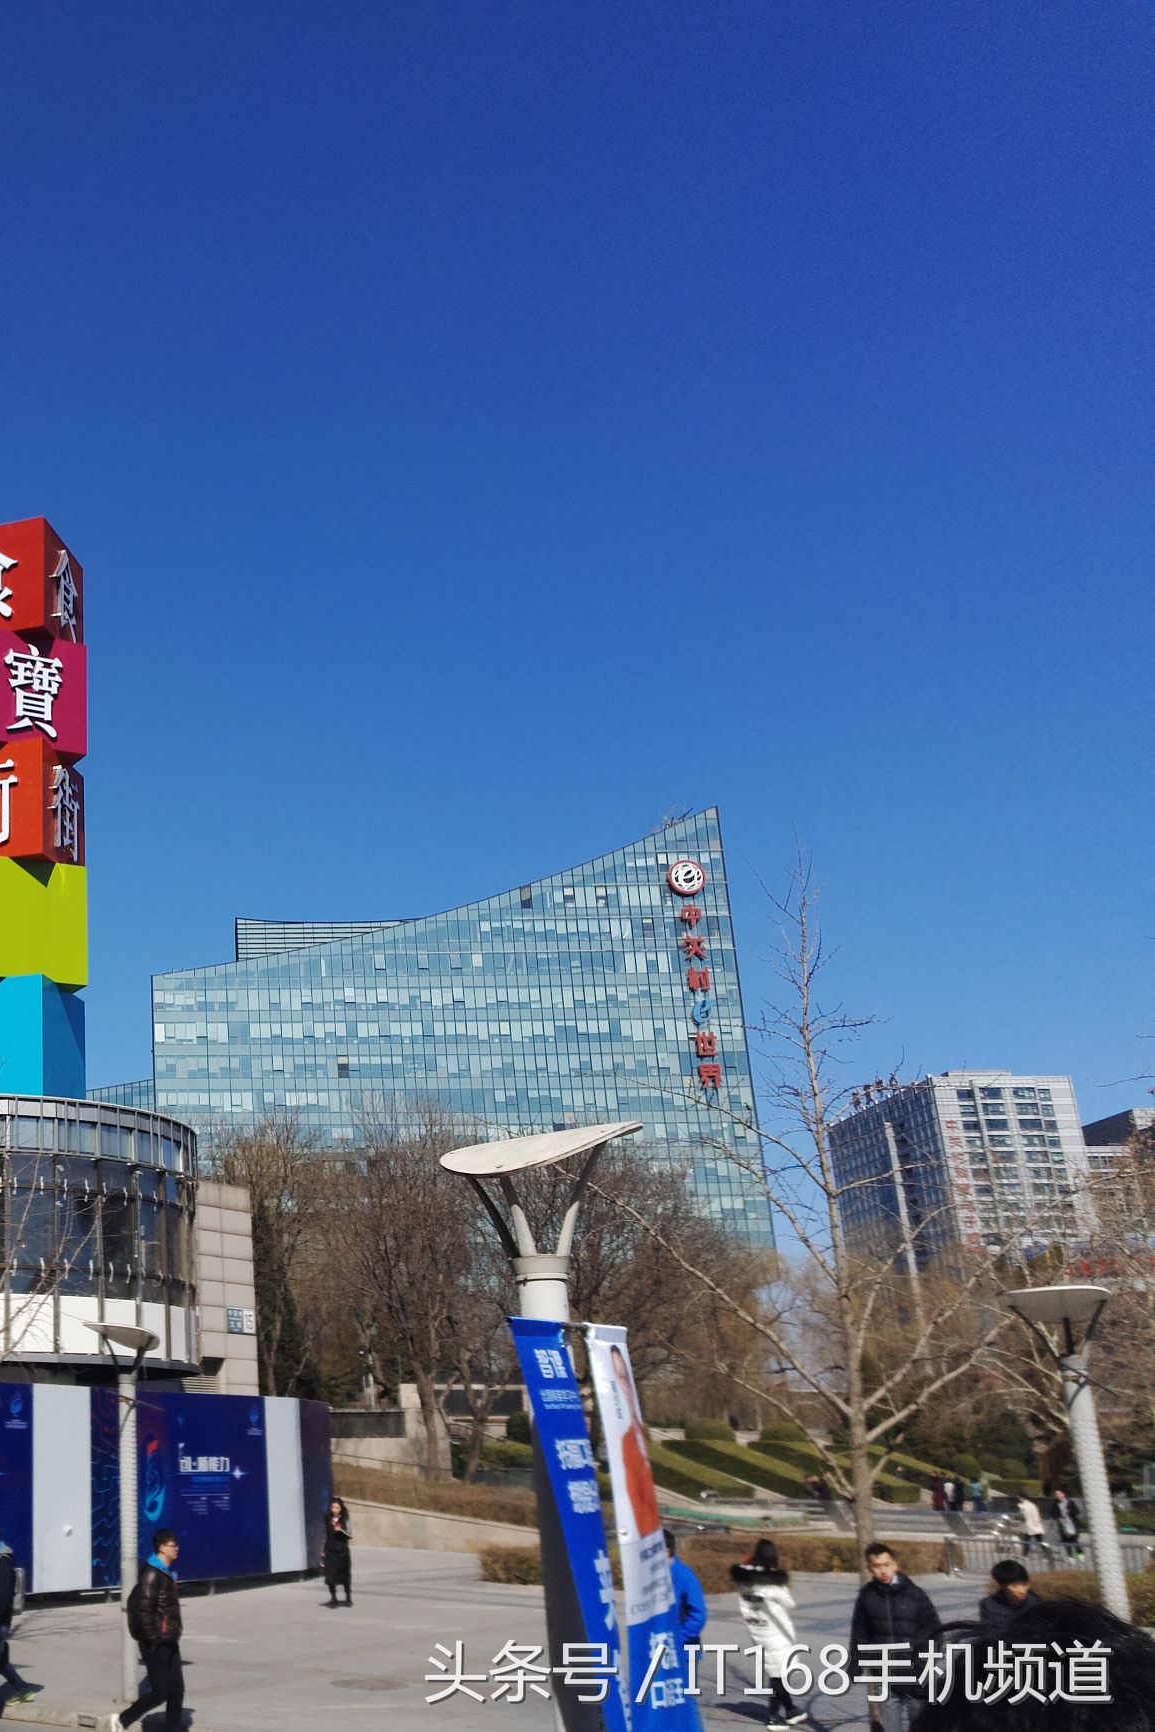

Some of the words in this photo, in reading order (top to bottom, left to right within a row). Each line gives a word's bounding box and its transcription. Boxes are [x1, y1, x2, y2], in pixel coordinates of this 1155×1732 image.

[679, 904, 723, 1089] 中关村e世界
